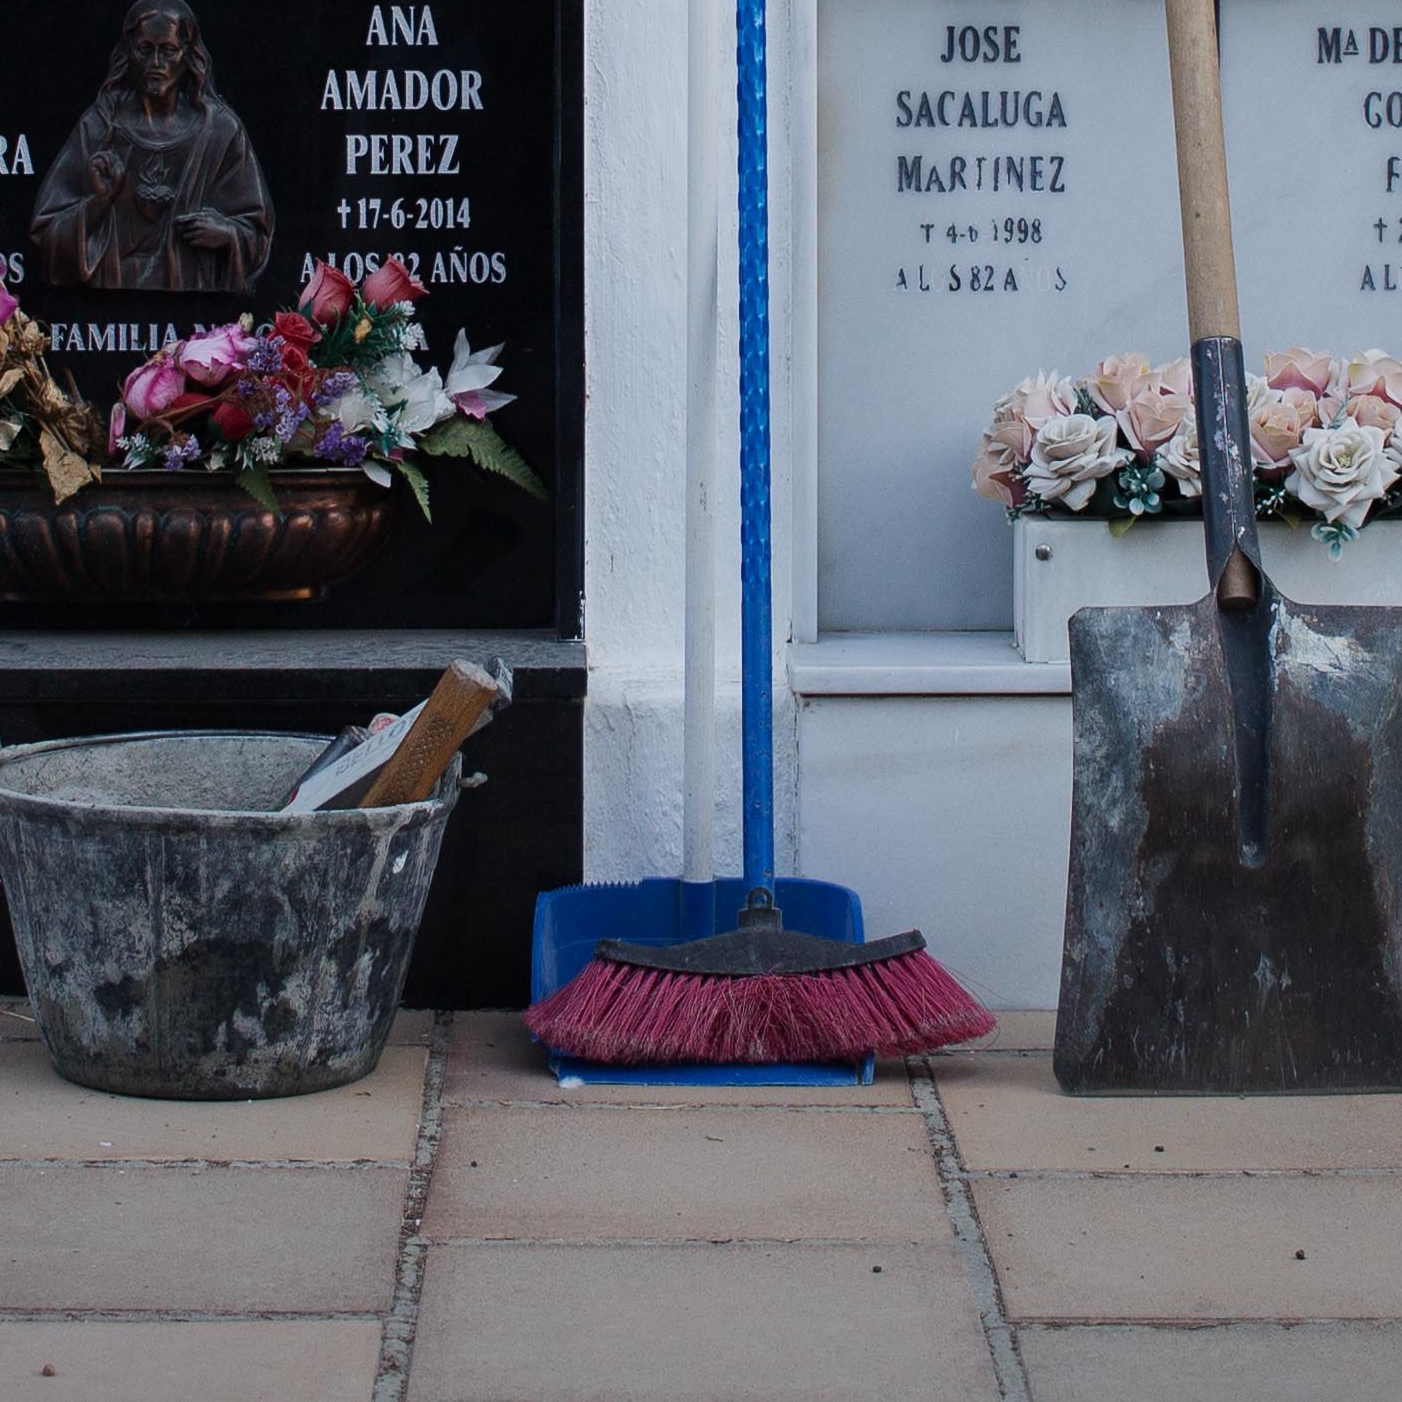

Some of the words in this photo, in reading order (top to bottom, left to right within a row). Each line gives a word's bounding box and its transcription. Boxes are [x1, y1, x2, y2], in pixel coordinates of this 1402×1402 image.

[365, 4, 439, 46] ANA
[940, 25, 1021, 64] JOSE
[320, 69, 484, 111] AMADOR
[896, 90, 1068, 129] SACALUGA
[345, 134, 460, 175] PEREZ
[897, 155, 1065, 193] MARTINEZ
[357, 197, 471, 230] 17-6-2014
[430, 245, 507, 284] AÑOS
[895, 267, 908, 290] A
[969, 264, 995, 292] 82
[1360, 264, 1377, 292] A
[51, 323, 176, 351] FAMILIA
